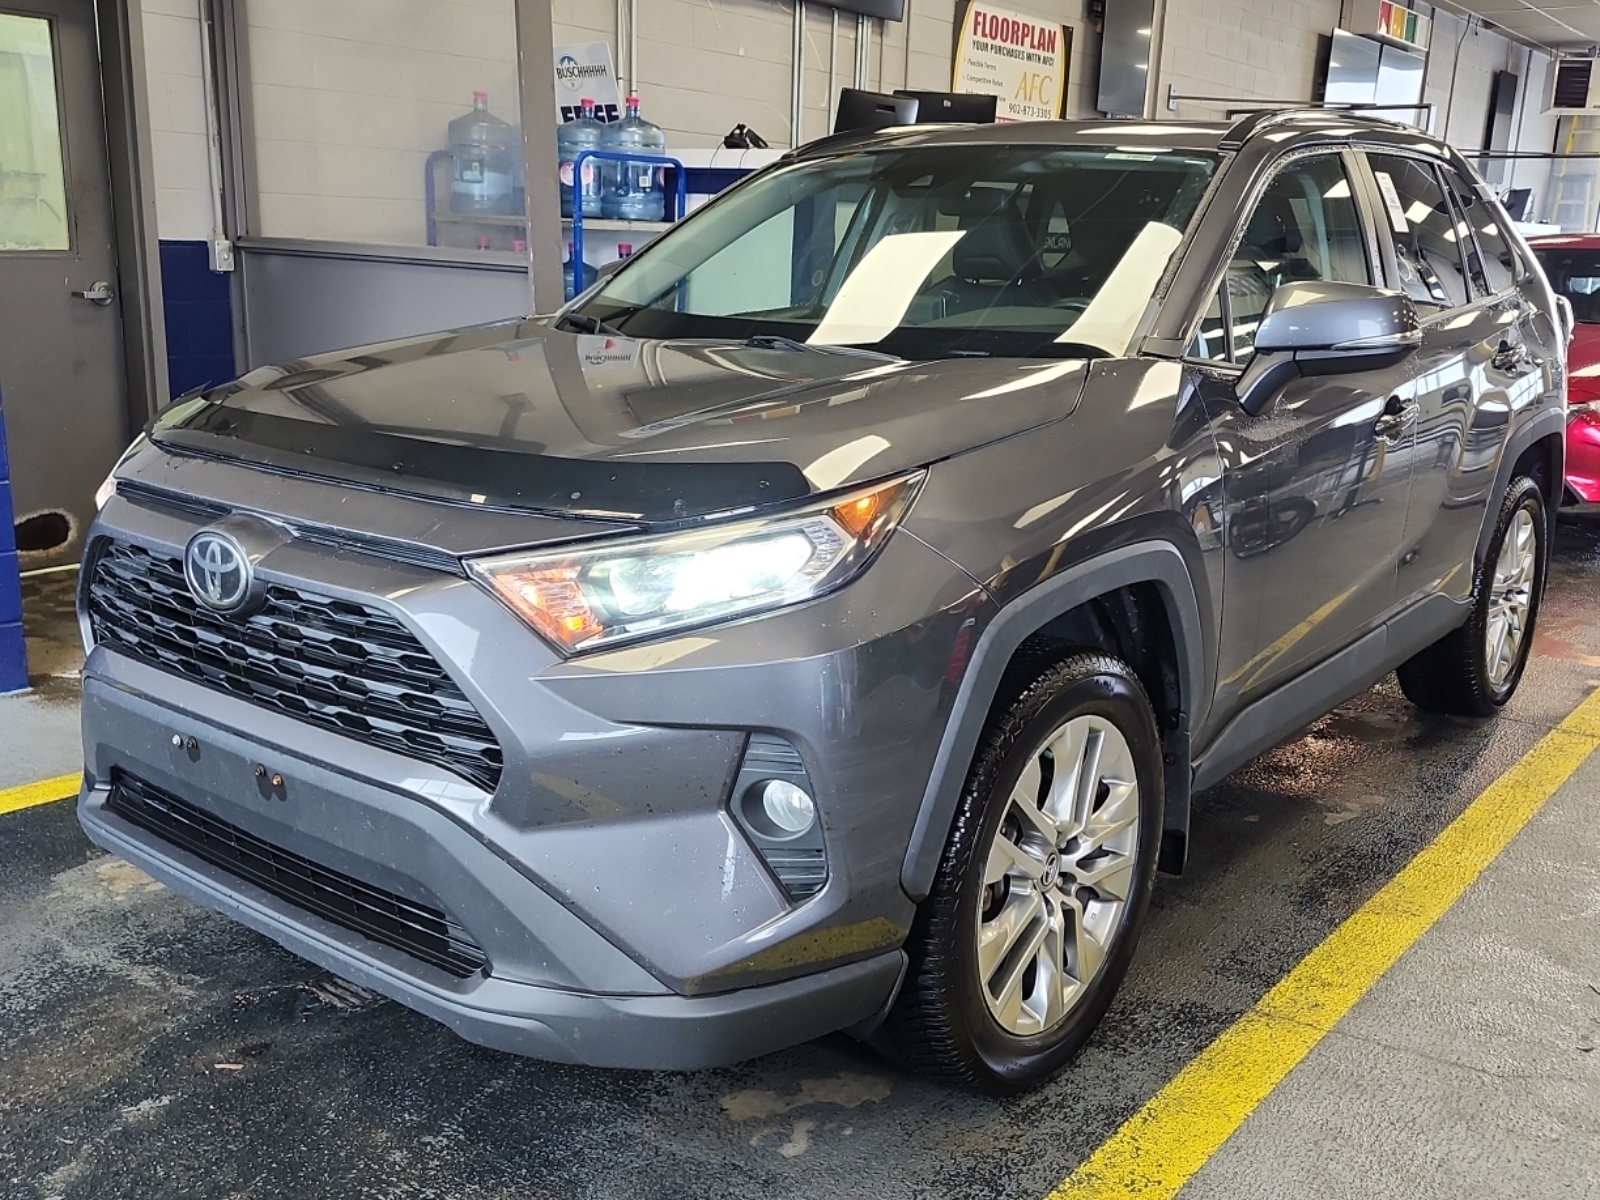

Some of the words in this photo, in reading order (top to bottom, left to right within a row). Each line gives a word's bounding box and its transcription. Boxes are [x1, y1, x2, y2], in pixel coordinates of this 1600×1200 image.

[973, 10, 1057, 54] FLOORPLAN
[972, 39, 989, 53] YOUR
[990, 44, 1026, 61] PURCHASES
[984, 61, 997, 71] Terms
[1014, 71, 1053, 105] AFC
